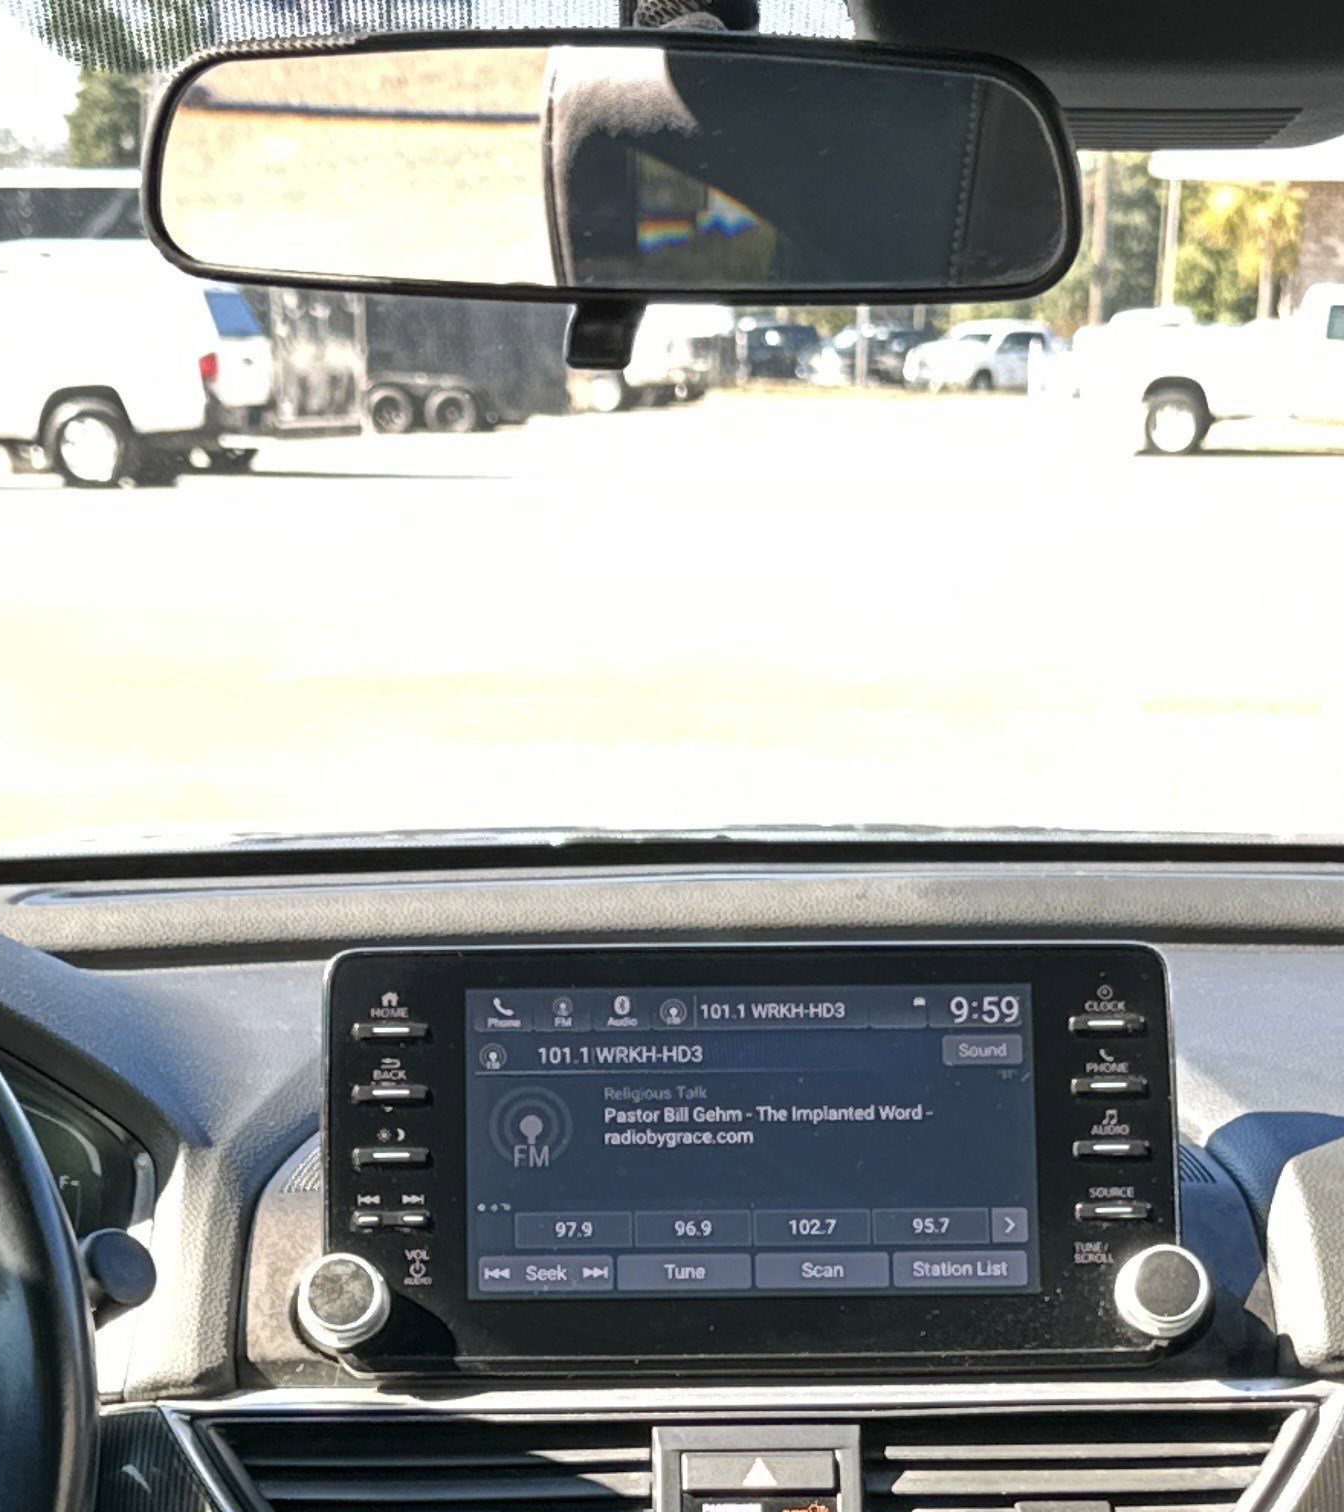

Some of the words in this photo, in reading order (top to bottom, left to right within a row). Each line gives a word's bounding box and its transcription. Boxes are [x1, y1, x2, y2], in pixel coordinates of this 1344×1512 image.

[370, 1006, 409, 1019] HOME
[700, 1003, 747, 1020] 101.1
[751, 1002, 846, 1019] WRKH-HD3
[950, 996, 1020, 1024] 9:59
[1084, 1001, 1126, 1013] CLOCK
[486, 1016, 522, 1029] Phone
[538, 1046, 589, 1065] 101.1
[595, 1044, 704, 1064] WRKH-HD3
[958, 1041, 1008, 1058] Sound
[372, 1068, 407, 1080] BACK
[1086, 1062, 1129, 1074] PHONE
[604, 1086, 672, 1102] Religious
[676, 1085, 708, 1100] Talk
[604, 1108, 660, 1124] Pastor
[663, 1107, 690, 1122] Bill
[693, 1106, 743, 1122] Gehm
[756, 1105, 789, 1122] The
[791, 1105, 876, 1124] Implanted
[879, 1104, 923, 1121] Word
[604, 1128, 754, 1147] radiobygrace.com
[1091, 1124, 1130, 1137] AUDIO
[513, 1145, 550, 1168] FM
[1089, 1186, 1135, 1198] SOURCE
[555, 1221, 594, 1238] 97.9
[674, 1220, 713, 1237] 96.9
[788, 1218, 837, 1236] 102.7
[912, 1217, 951, 1234] 95.7
[405, 1250, 430, 1261] VOL
[525, 1264, 568, 1282] Seek
[663, 1263, 706, 1281] Tune
[801, 1262, 845, 1279] Scan
[912, 1261, 973, 1278] Station
[976, 1259, 1009, 1277] List
